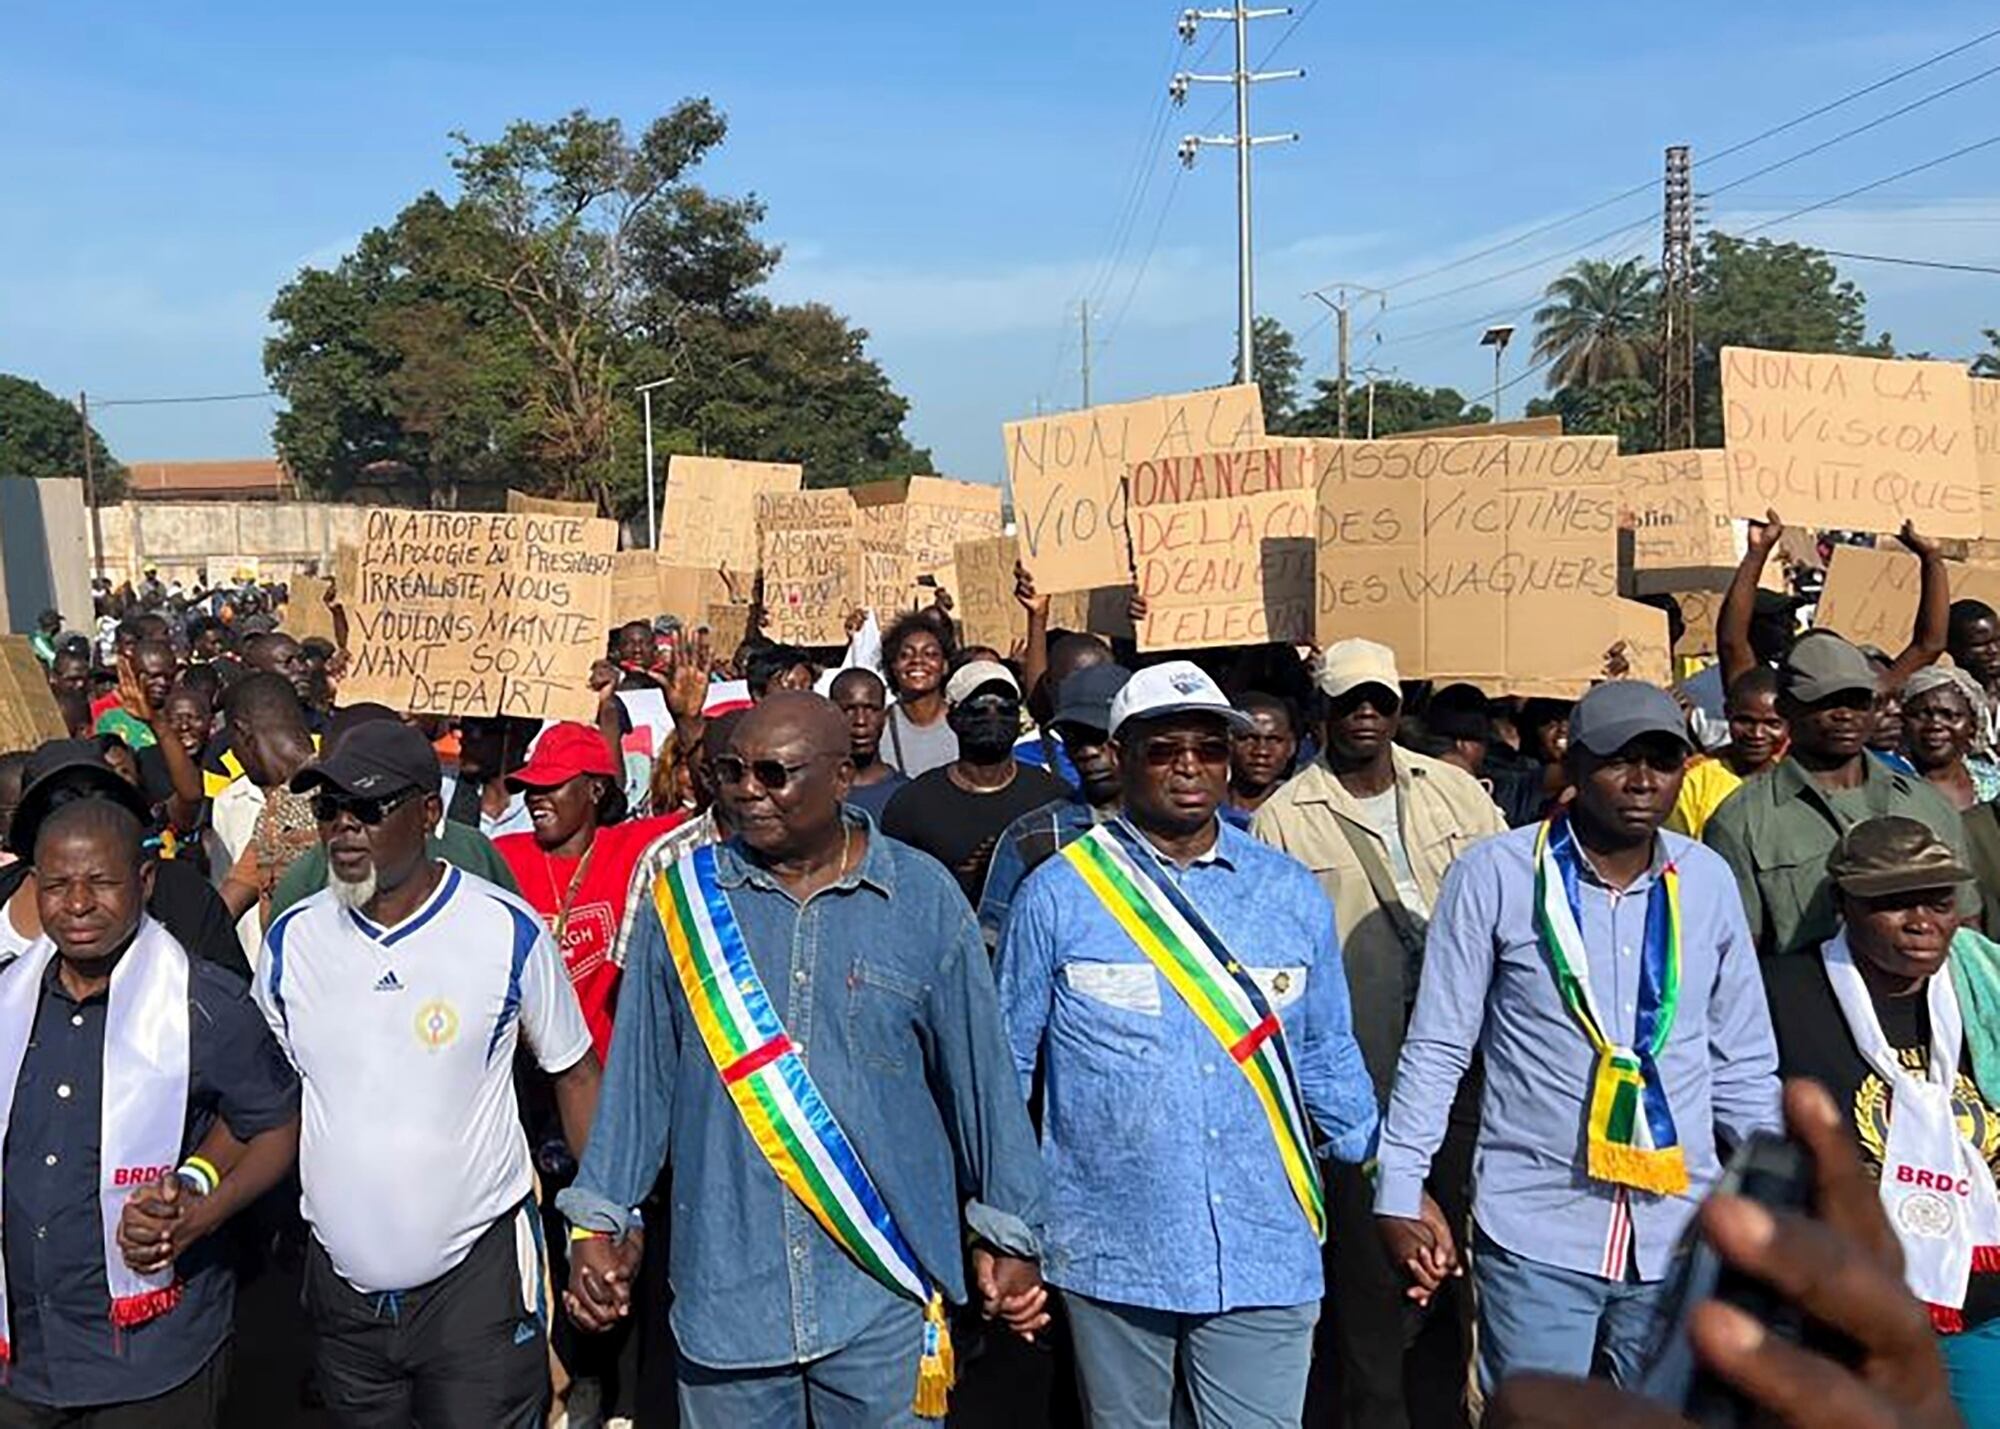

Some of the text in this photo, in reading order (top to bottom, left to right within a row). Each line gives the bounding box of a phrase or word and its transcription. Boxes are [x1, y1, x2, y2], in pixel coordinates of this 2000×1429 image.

[1726, 351, 1814, 391] NON
[1822, 363, 1847, 398] A
[1873, 364, 1932, 402] LA
[1013, 396, 1255, 481] NON A LA
[1317, 440, 1614, 498] ASSOCIATION
[1733, 450, 1975, 516] POLITIQUE
[367, 510, 396, 541] ON
[400, 513, 418, 540] A
[419, 513, 481, 541] TROP
[1319, 488, 1614, 549] DES VICTIMES
[493, 571, 571, 606] NOUS
[1142, 554, 1244, 598] D'EAU
[1319, 553, 1615, 614] DES WAGNERS
[356, 609, 473, 643] VOULONS
[352, 643, 556, 678] NANT SON
[1896, 1164, 1972, 1197] BRDC
